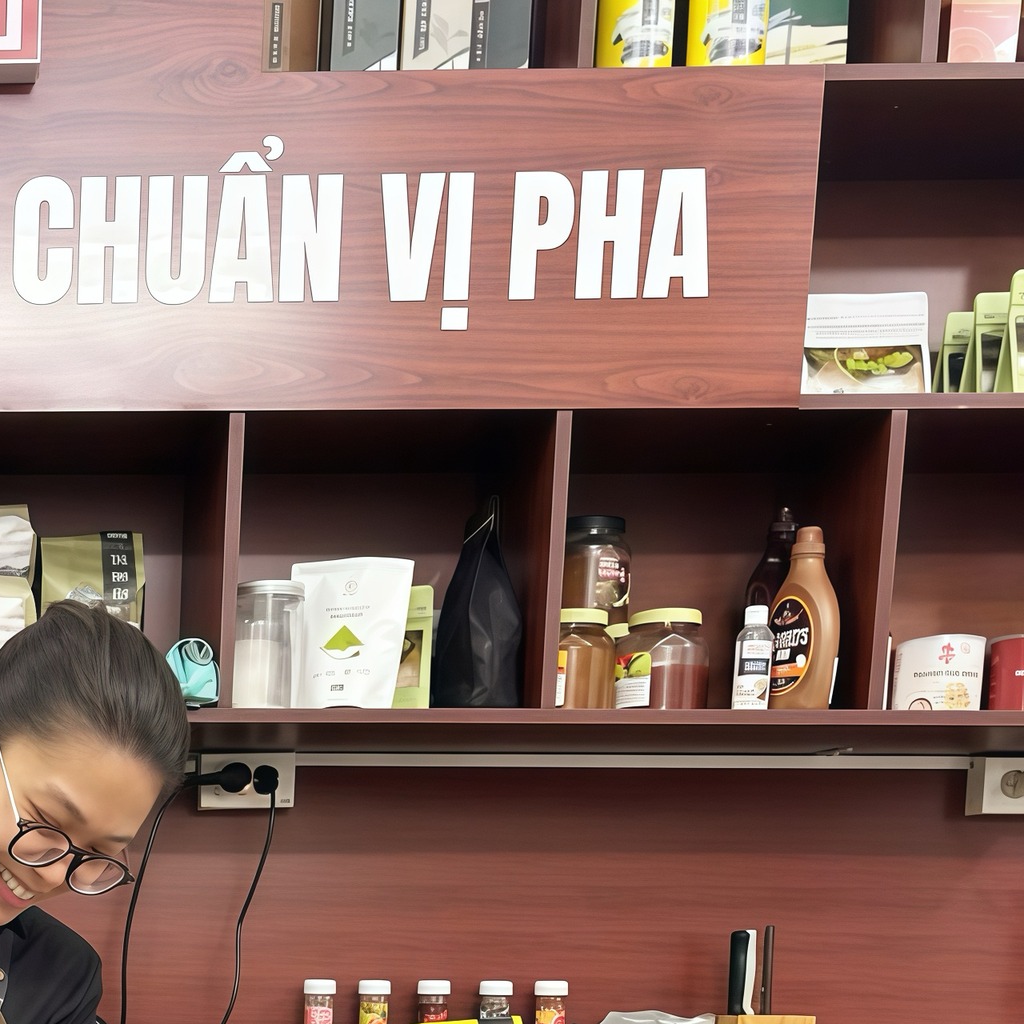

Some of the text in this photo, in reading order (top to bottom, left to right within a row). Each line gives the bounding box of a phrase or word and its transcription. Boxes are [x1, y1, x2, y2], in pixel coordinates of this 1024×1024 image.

[11, 134, 345, 306] CHUẨN
[380, 171, 476, 332] VỊ
[507, 167, 710, 301] PHA
